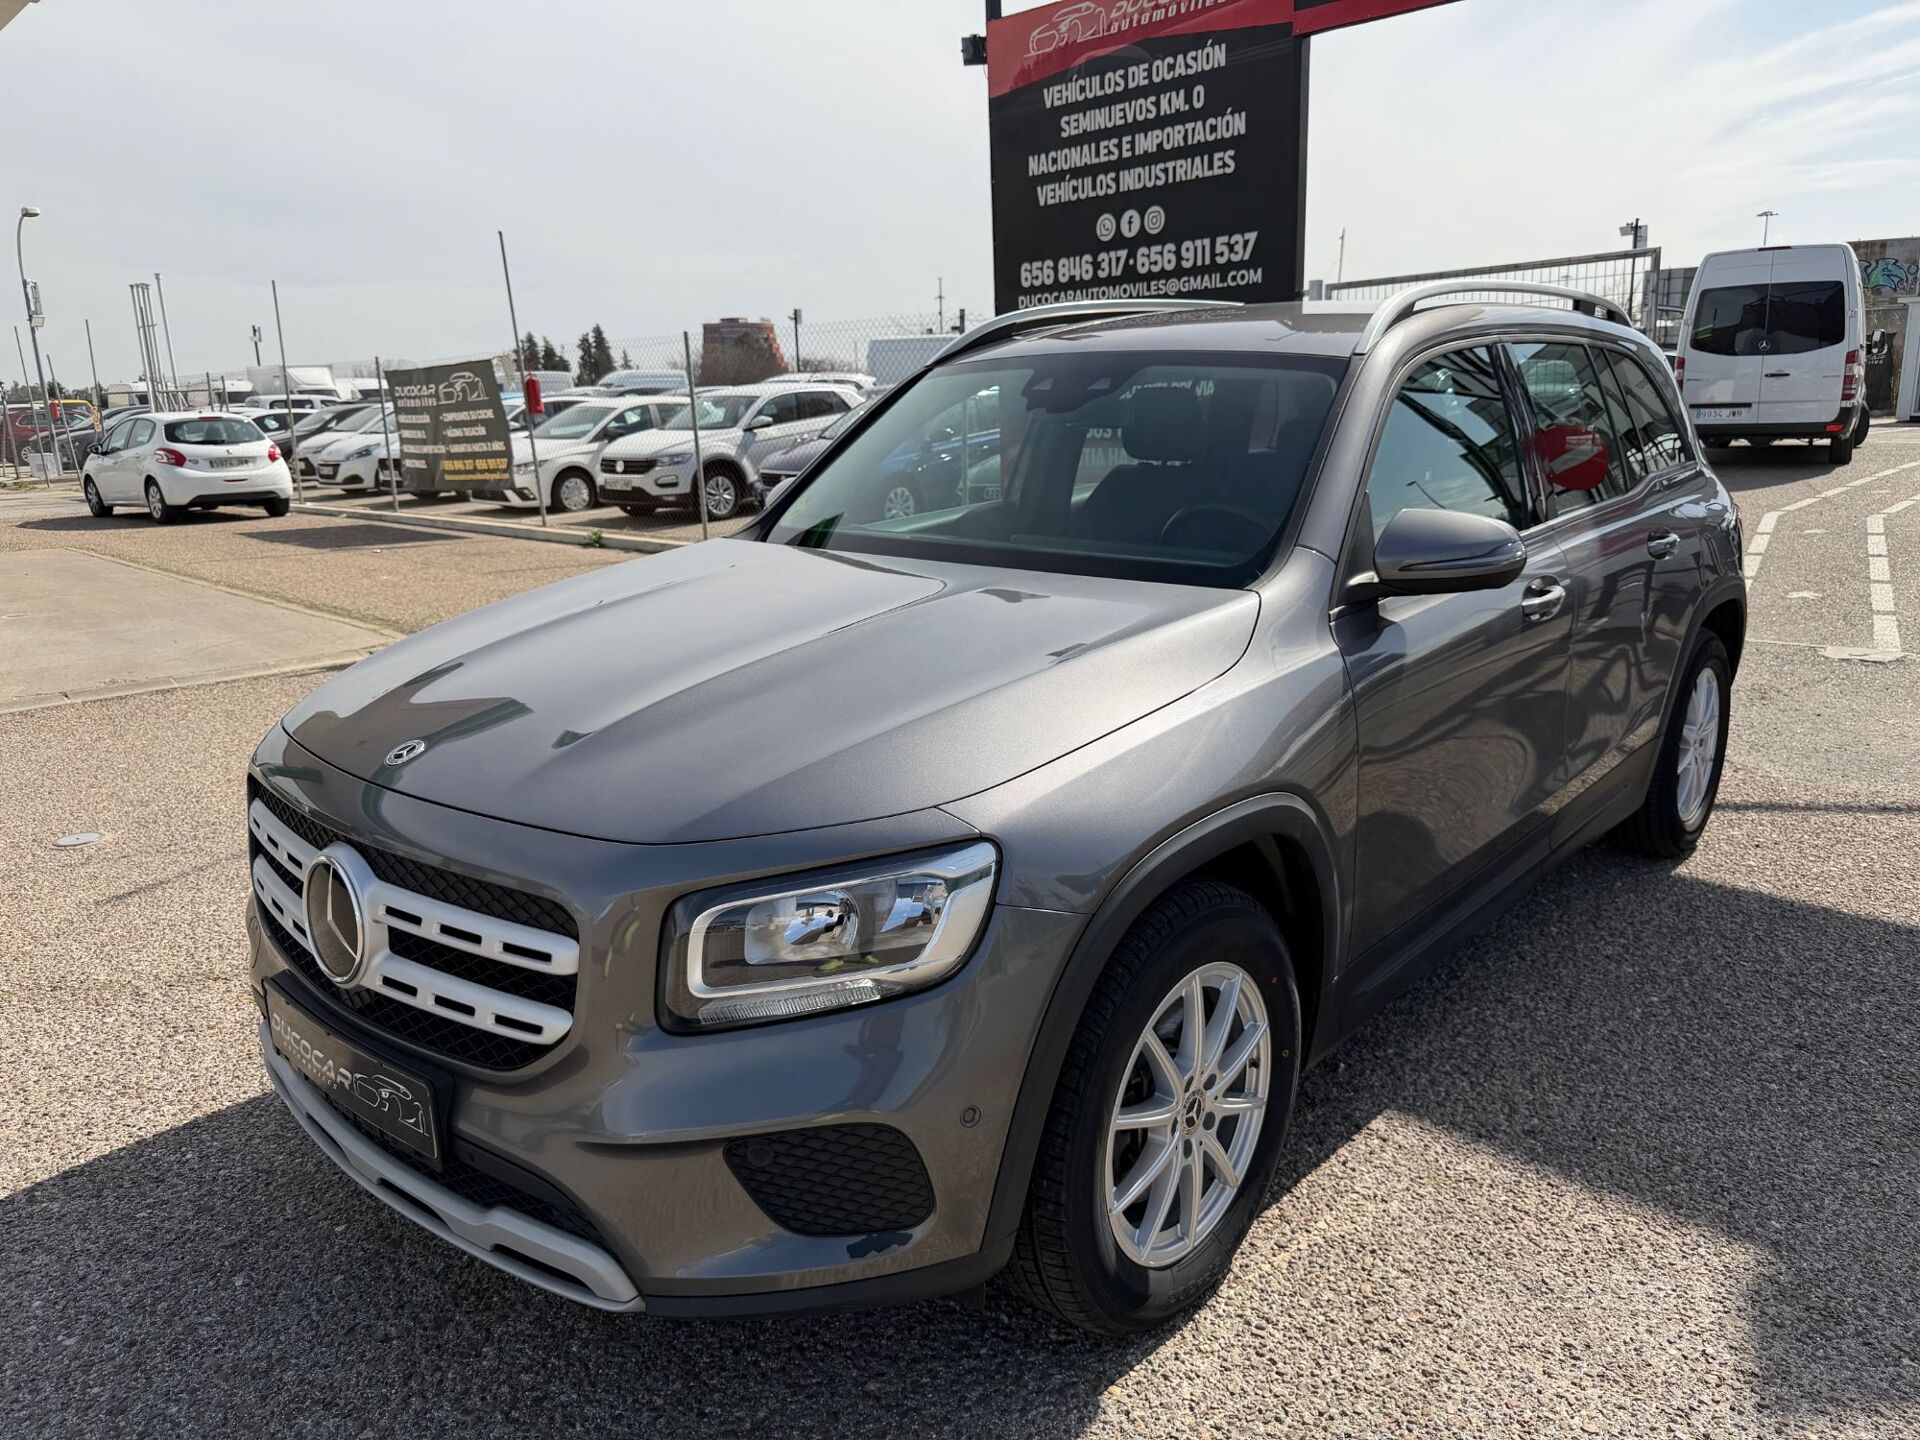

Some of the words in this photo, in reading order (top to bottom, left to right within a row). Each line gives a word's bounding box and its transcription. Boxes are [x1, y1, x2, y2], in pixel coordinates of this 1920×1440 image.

[1043, 69, 1125, 109] VEHÍCULOS
[1128, 63, 1149, 89] DE
[1152, 39, 1226, 84] OCASIÓN
[1028, 138, 1119, 177] NACIONALES
[1122, 136, 1132, 158] E
[1135, 107, 1247, 155] IMPORTACIÓN
[1060, 96, 1157, 138] SEMINUEVOS
[1160, 88, 1190, 117] KM.
[1037, 171, 1117, 207] VEHÍCULOS
[1119, 149, 1236, 192] INDUSTRIALES
[1018, 268, 1263, 310] DUCOCARAUTOMOVILES@GMAIL.COM
[1020, 259, 1054, 289] 656
[1057, 254, 1094, 284] 846
[1180, 237, 1211, 269] 911
[1215, 231, 1259, 265] 537
[394, 384, 436, 397] DUCOCAR
[271, 1012, 352, 1090] DUCOCAR
